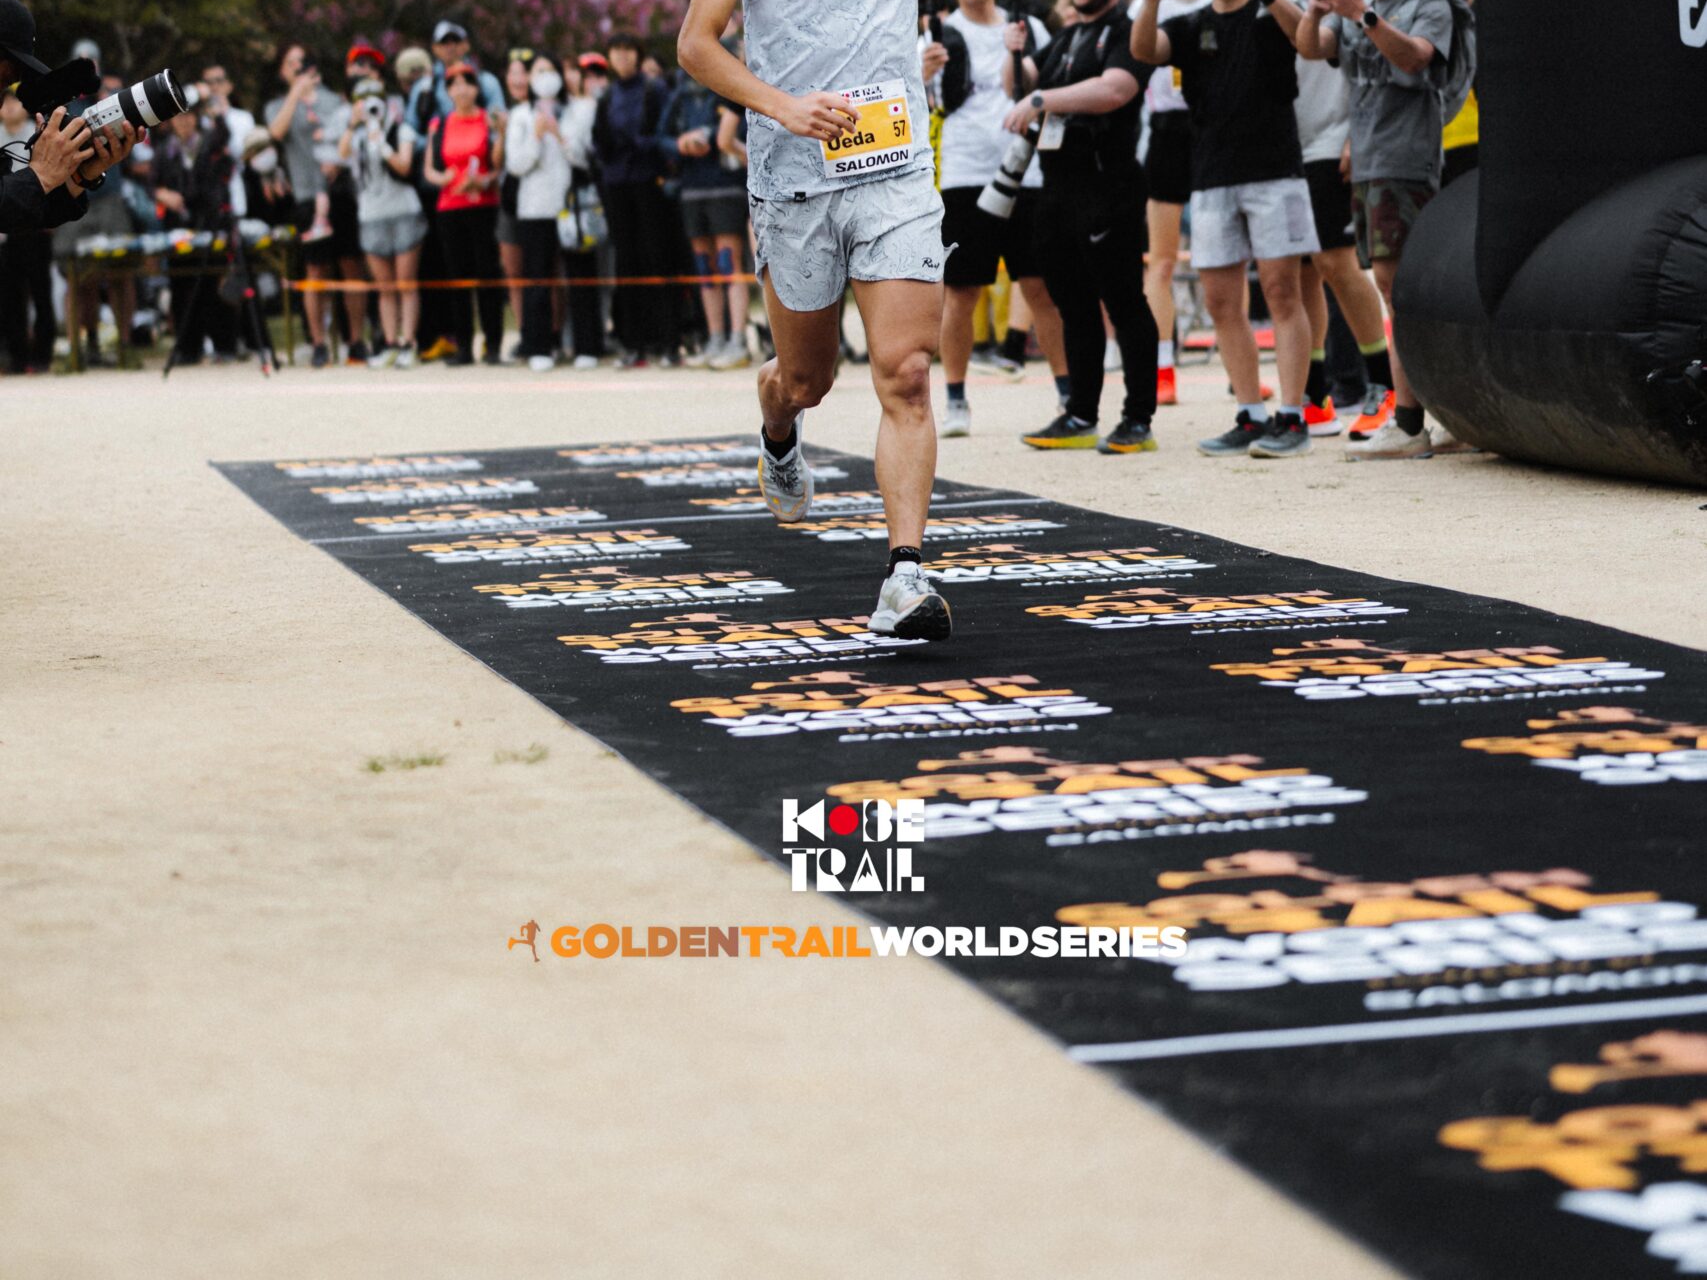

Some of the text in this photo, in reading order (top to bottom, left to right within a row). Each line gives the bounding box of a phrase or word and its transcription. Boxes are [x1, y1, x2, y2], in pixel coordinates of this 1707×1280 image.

[893, 120, 906, 137] 57
[827, 131, 875, 151] Ueda
[835, 149, 909, 173] SALOMON
